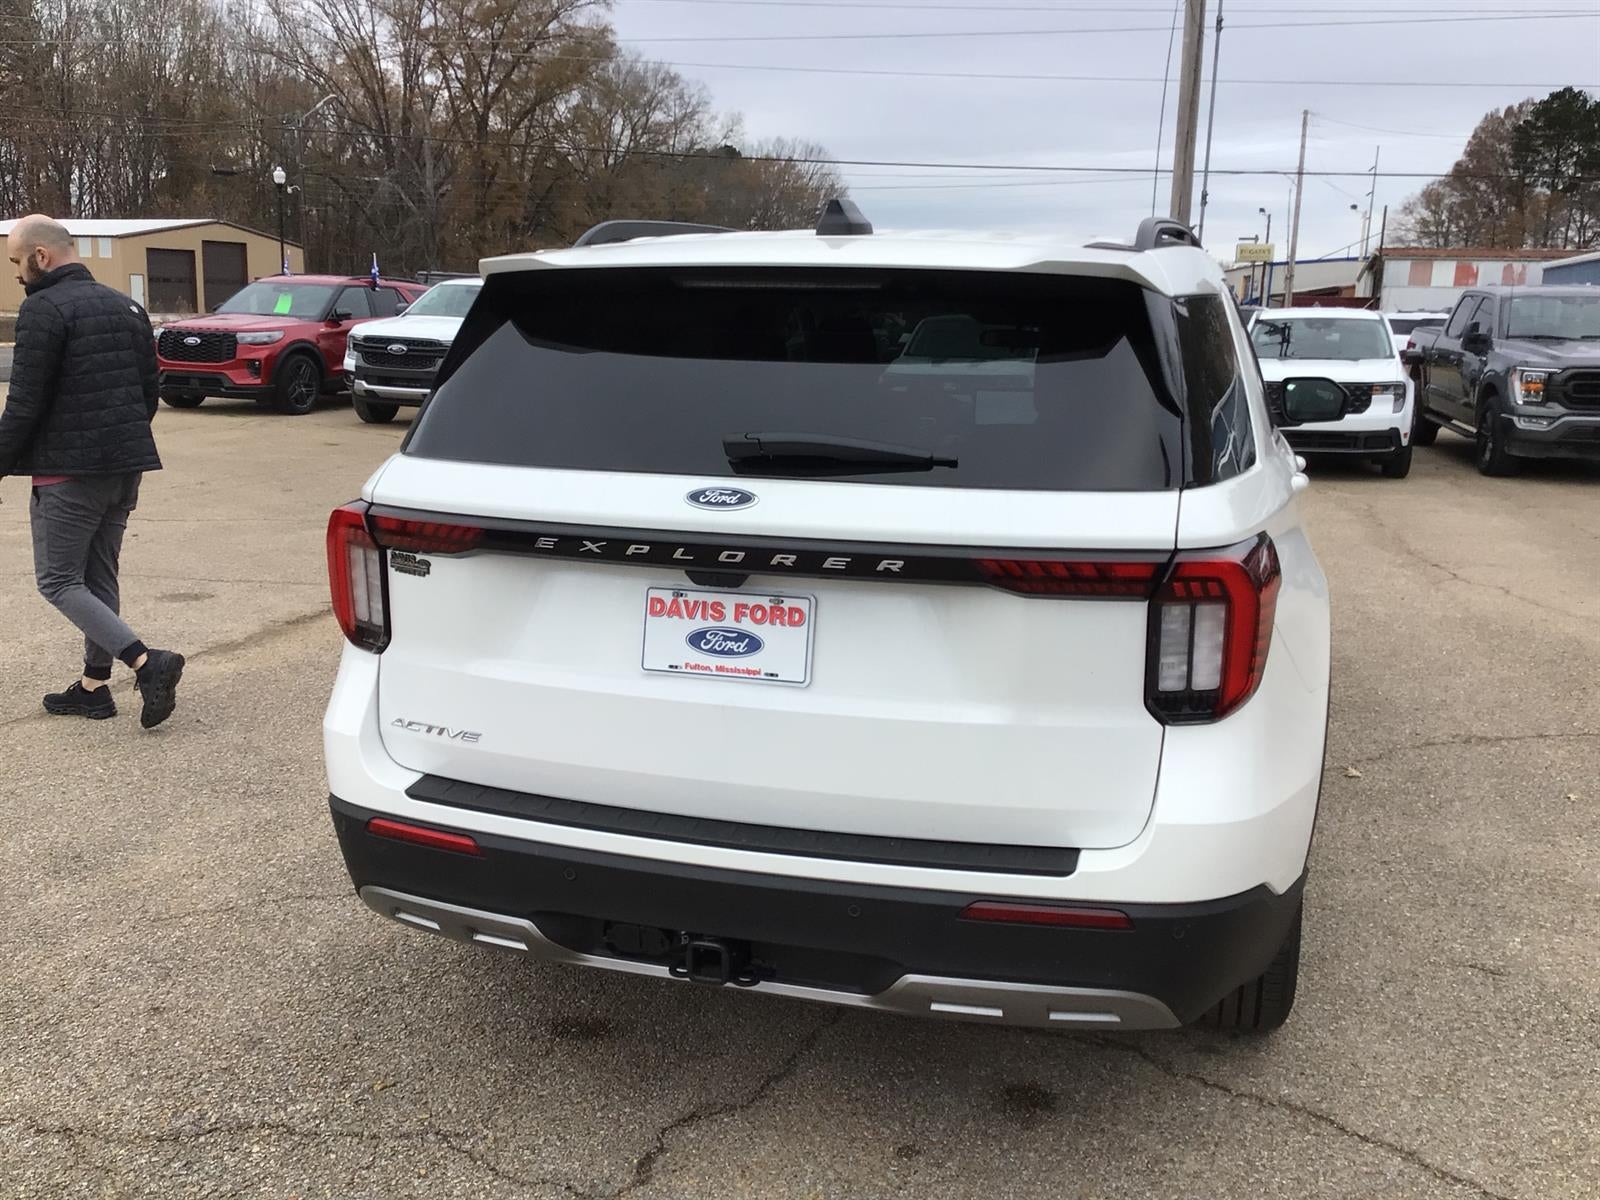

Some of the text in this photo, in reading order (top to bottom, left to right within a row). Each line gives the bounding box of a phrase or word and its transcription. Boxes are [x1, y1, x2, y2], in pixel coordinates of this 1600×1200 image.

[699, 490, 742, 504] Ford
[535, 537, 905, 573] EXPLORER
[648, 595, 806, 627] DAVIS FORD
[700, 630, 749, 652] Ford
[684, 662, 761, 676] Fulton, Mississippi
[391, 718, 482, 743] ACTIVE
